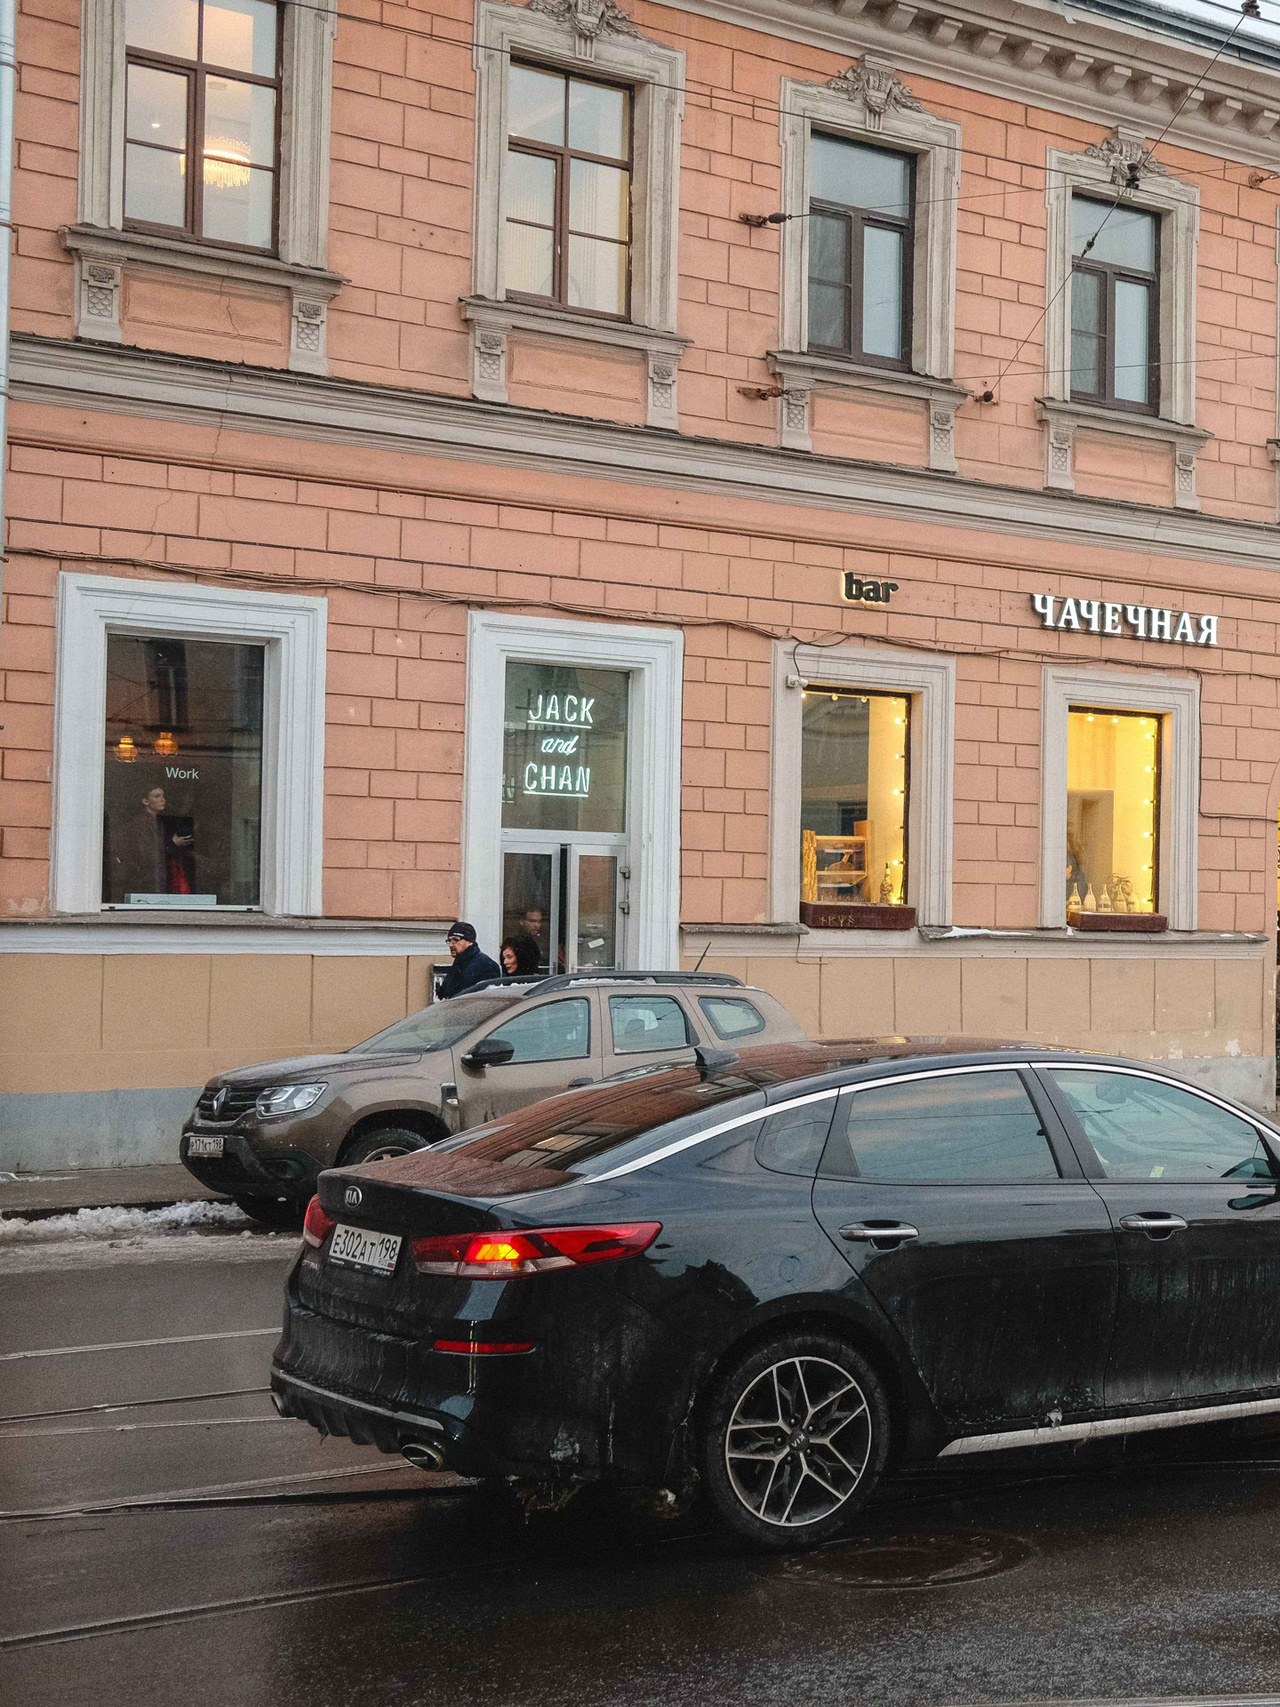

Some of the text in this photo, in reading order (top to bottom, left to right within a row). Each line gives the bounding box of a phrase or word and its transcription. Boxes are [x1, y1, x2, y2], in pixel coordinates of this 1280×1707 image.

[844, 571, 899, 603] bar
[1031, 593, 1219, 645] ЧАЧЕЧНАЯ
[528, 694, 595, 723] JACK
[541, 735, 580, 756] and
[165, 766, 199, 780] Work
[524, 761, 591, 793] CHAN
[345, 1188, 359, 1205] KIA
